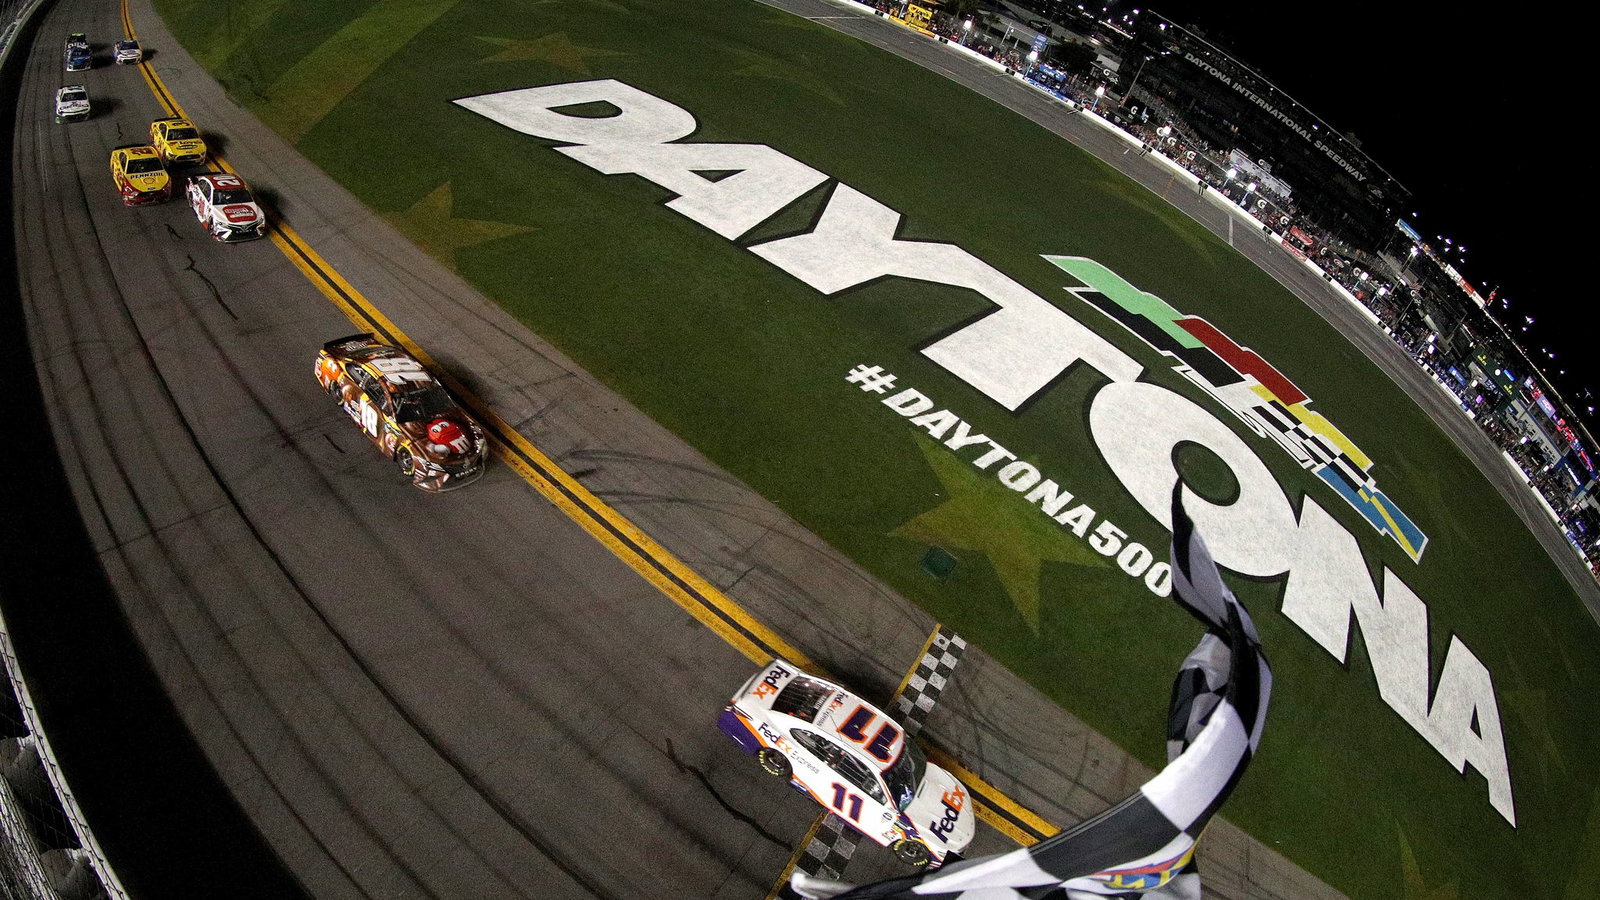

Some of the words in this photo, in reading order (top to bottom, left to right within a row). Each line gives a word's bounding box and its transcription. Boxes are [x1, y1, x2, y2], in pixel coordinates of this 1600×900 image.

[1185, 53, 1232, 86] DAYTONA
[1232, 82, 1312, 142] INTERNATIONAL
[1314, 140, 1366, 182] SPEEDWAY
[213, 175, 241, 186] 20
[370, 357, 432, 385] 18
[359, 399, 378, 438] 18
[451, 78, 1517, 828] DAYTONA
[845, 363, 1173, 597] #DAYTONA500
[752, 665, 791, 700] FedEx
[828, 691, 849, 709] FedEx
[758, 722, 793, 754] FedEx
[790, 750, 820, 775] Express
[836, 704, 901, 763] 11
[831, 781, 865, 823] 11
[929, 784, 967, 844] FedEx
